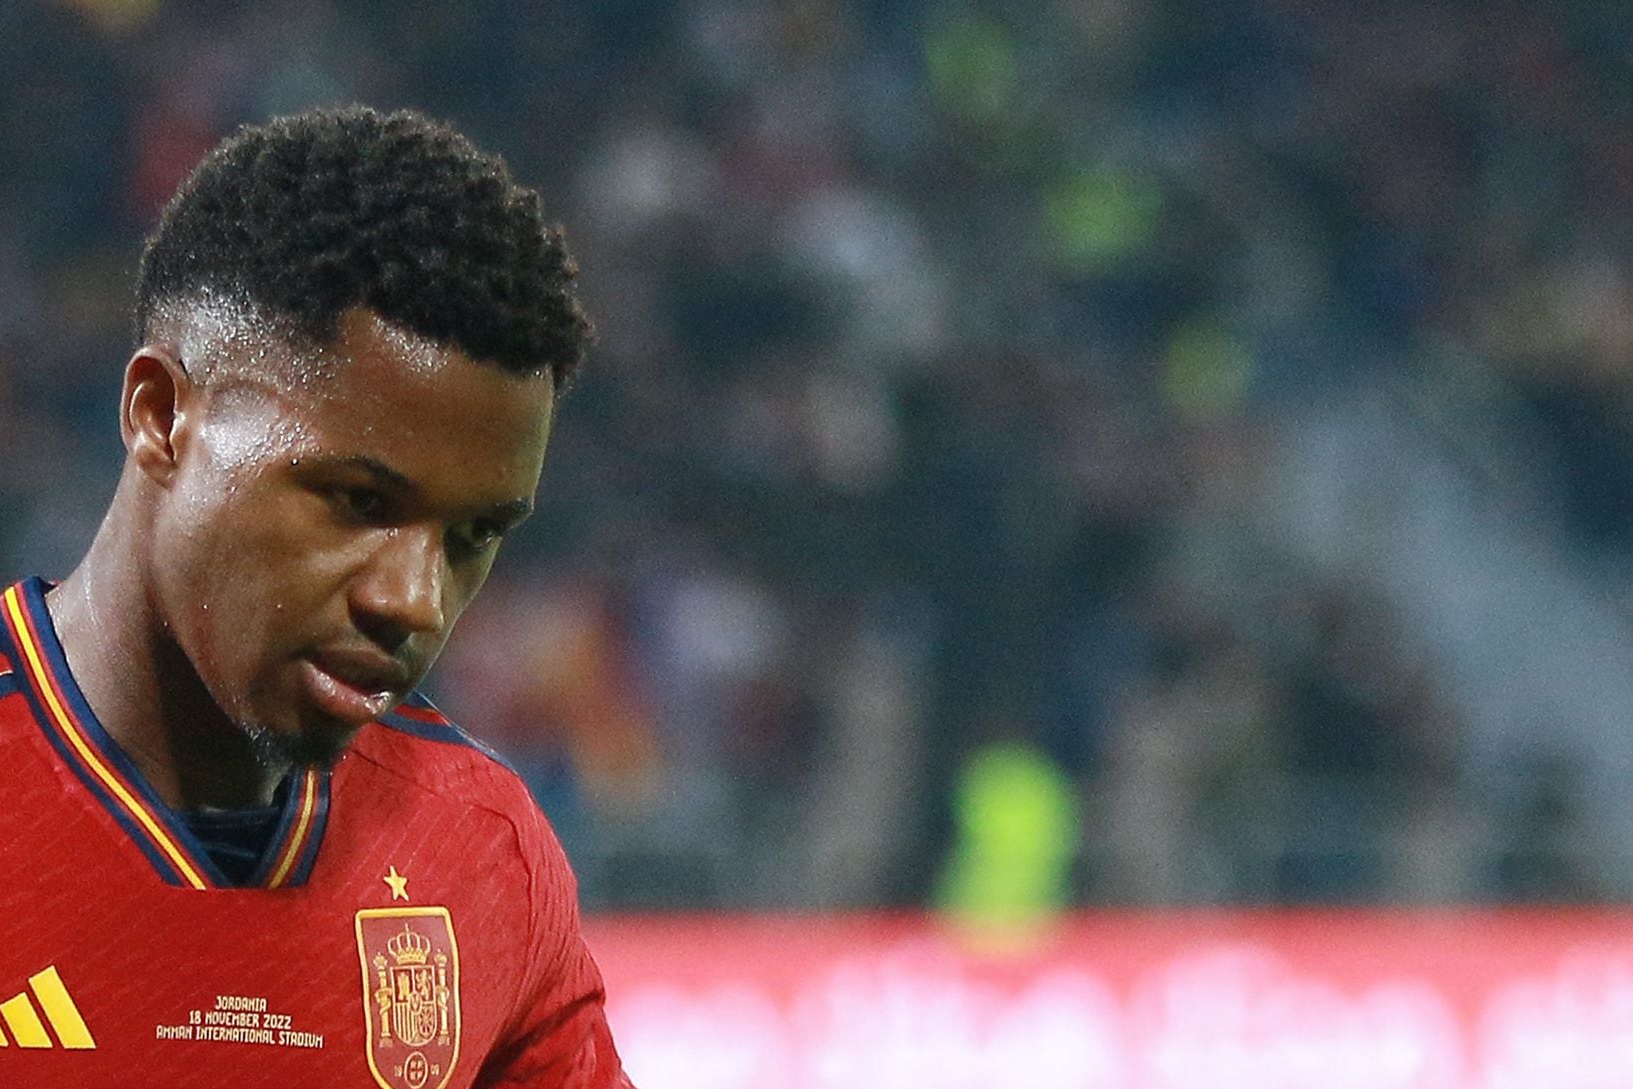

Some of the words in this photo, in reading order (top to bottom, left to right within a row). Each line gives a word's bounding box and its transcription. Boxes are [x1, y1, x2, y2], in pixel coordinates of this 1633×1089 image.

[215, 996, 267, 1012] JORDANIA
[189, 1010, 202, 1025] 18
[205, 1011, 260, 1027] NOVEMBER
[263, 1015, 292, 1030] 2022
[156, 1025, 193, 1040] AMMAN
[195, 1026, 276, 1045] INTERNATIONAL
[278, 1032, 324, 1049] STADIUM
